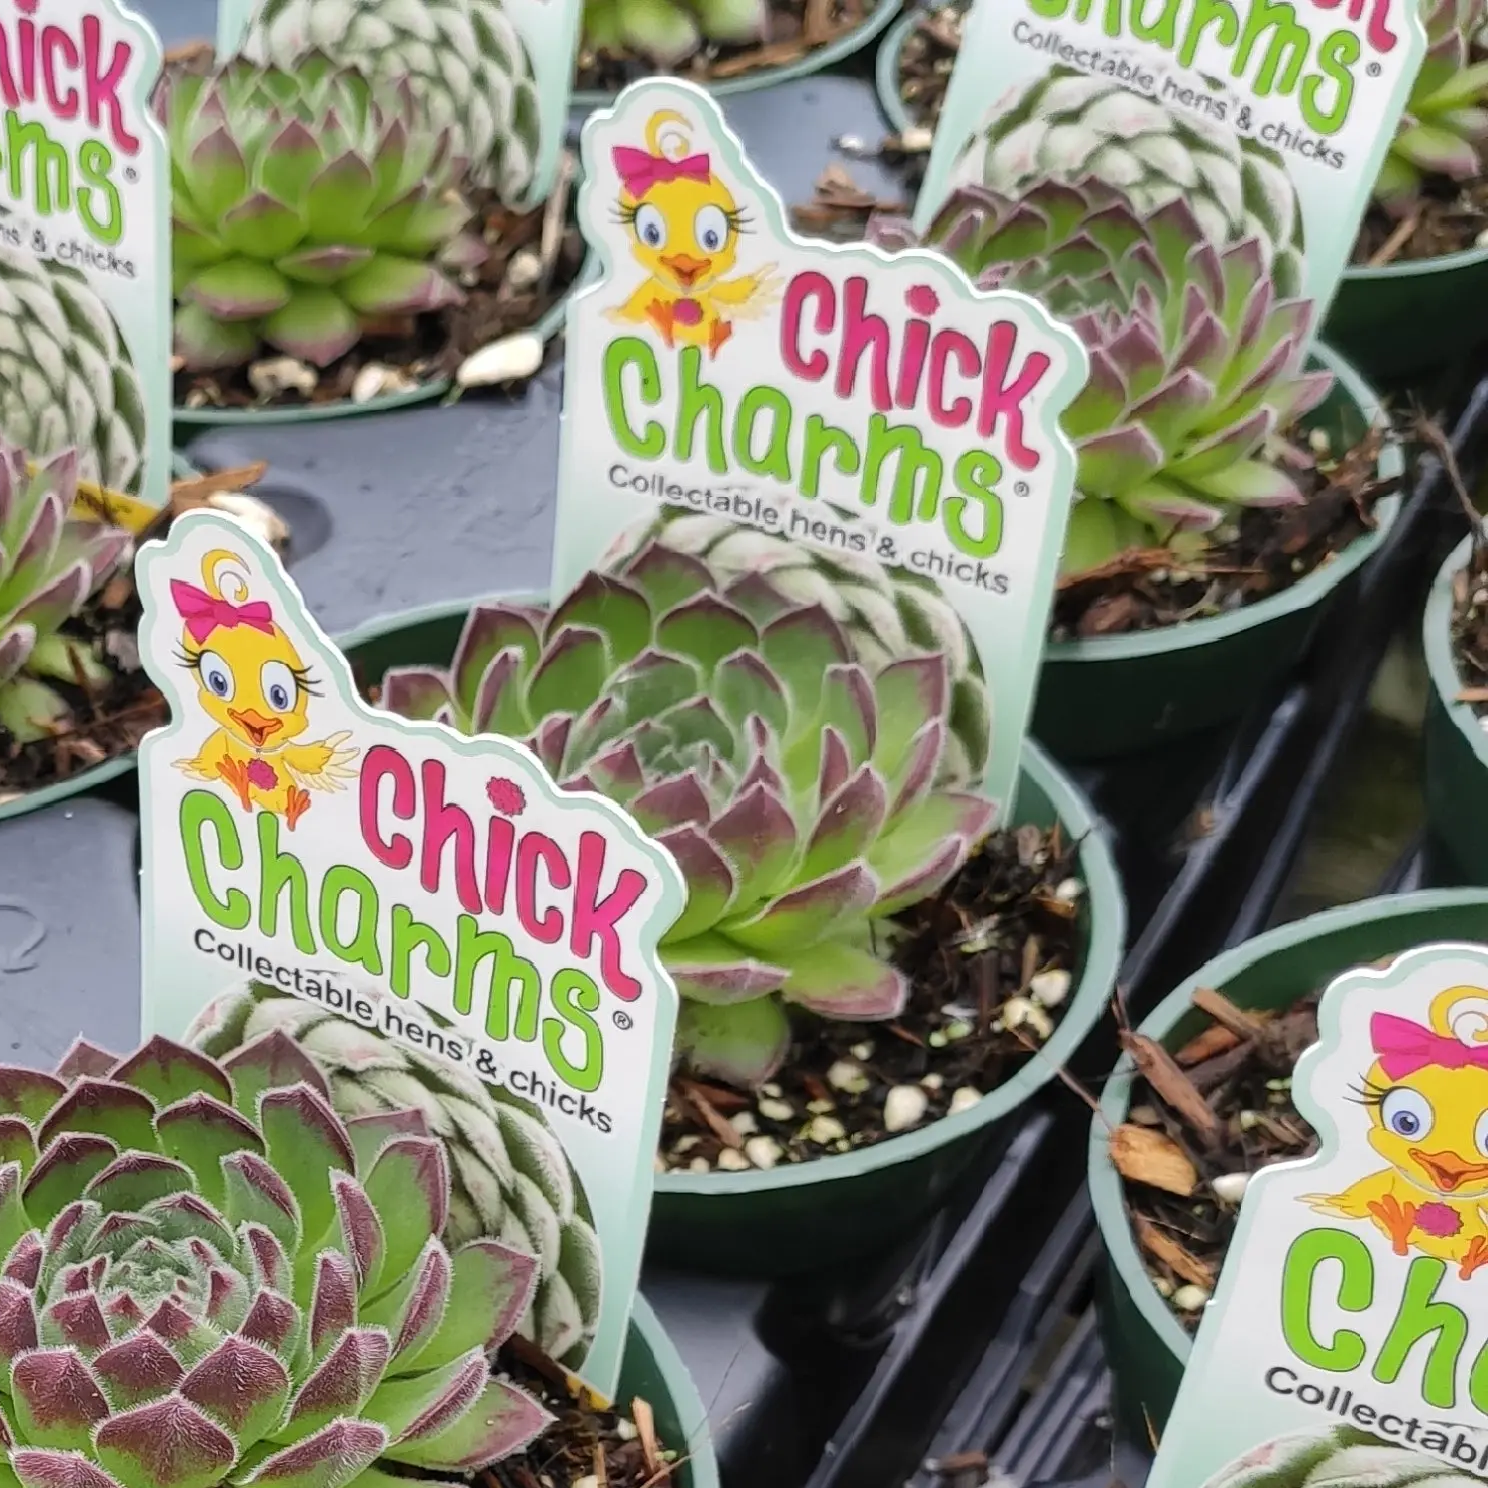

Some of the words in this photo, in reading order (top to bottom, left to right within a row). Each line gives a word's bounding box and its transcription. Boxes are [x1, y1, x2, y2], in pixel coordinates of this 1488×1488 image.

[1012, 19, 1155, 92] Collectable
[1162, 74, 1228, 120] hens
[1236, 106, 1252, 132] &
[1260, 116, 1346, 170] chicks
[602, 336, 1004, 558] Charms
[781, 270, 1050, 471] Chick
[608, 463, 779, 526] Collectable
[790, 508, 867, 552] hens
[876, 537, 897, 560] &
[910, 548, 1010, 595] chicks
[178, 789, 605, 1092] Charms
[358, 744, 648, 1002] Chick
[192, 928, 374, 1022] Collectable
[384, 1004, 464, 1062] hens
[475, 1048, 497, 1077] &
[510, 1067, 613, 1135] chicks
[1280, 1226, 1488, 1416] Ch
